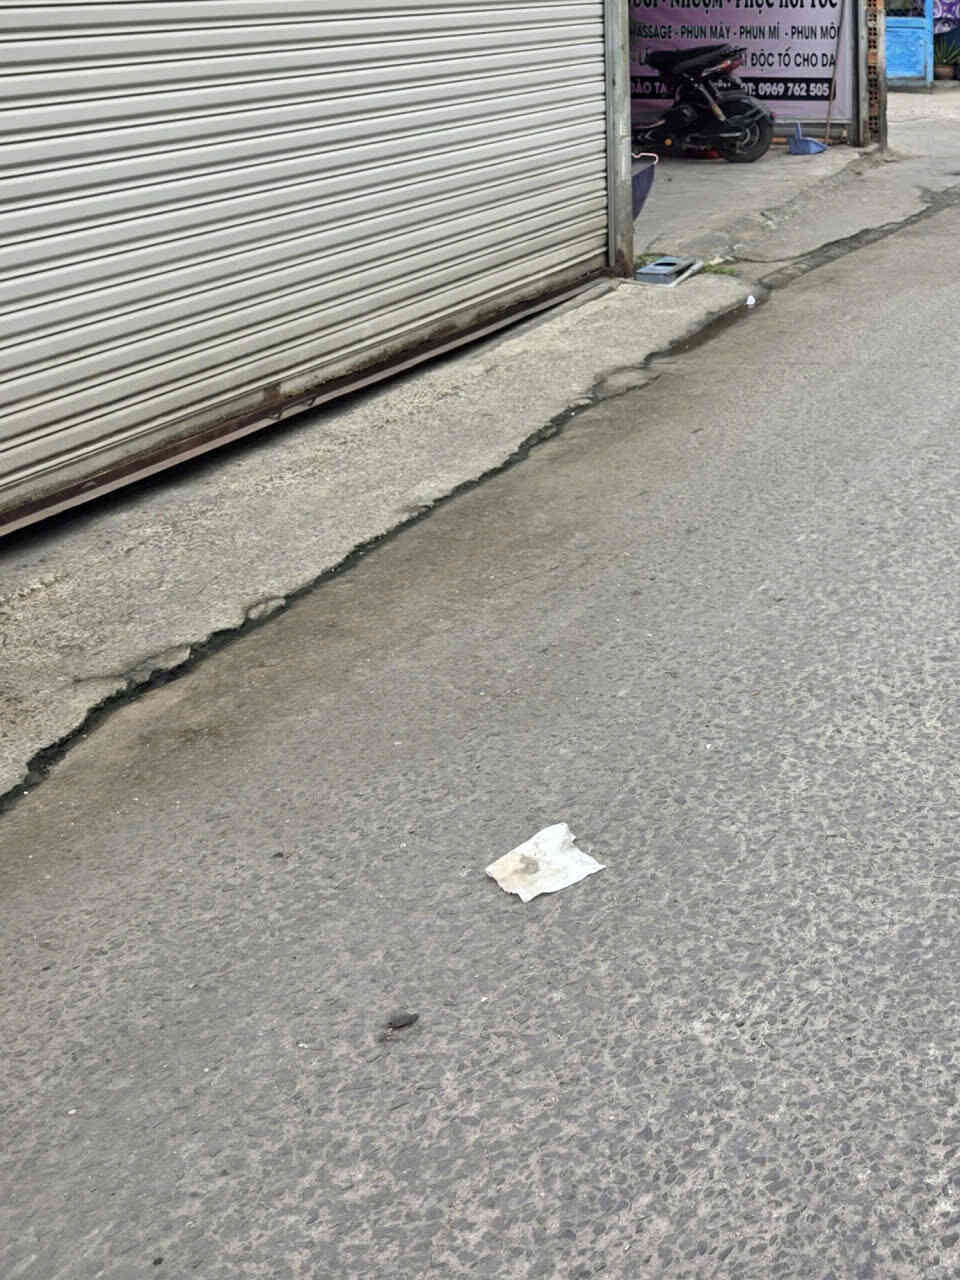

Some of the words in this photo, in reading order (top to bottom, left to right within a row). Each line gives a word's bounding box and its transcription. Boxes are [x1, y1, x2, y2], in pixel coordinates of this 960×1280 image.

[680, 25, 707, 39] PHUN
[739, 25, 766, 40] PHUN
[790, 25, 817, 40] PHUN
[794, 53, 819, 67] CHO
[758, 82, 784, 96] 0969
[786, 82, 807, 96] 762
[809, 82, 830, 96] 505
